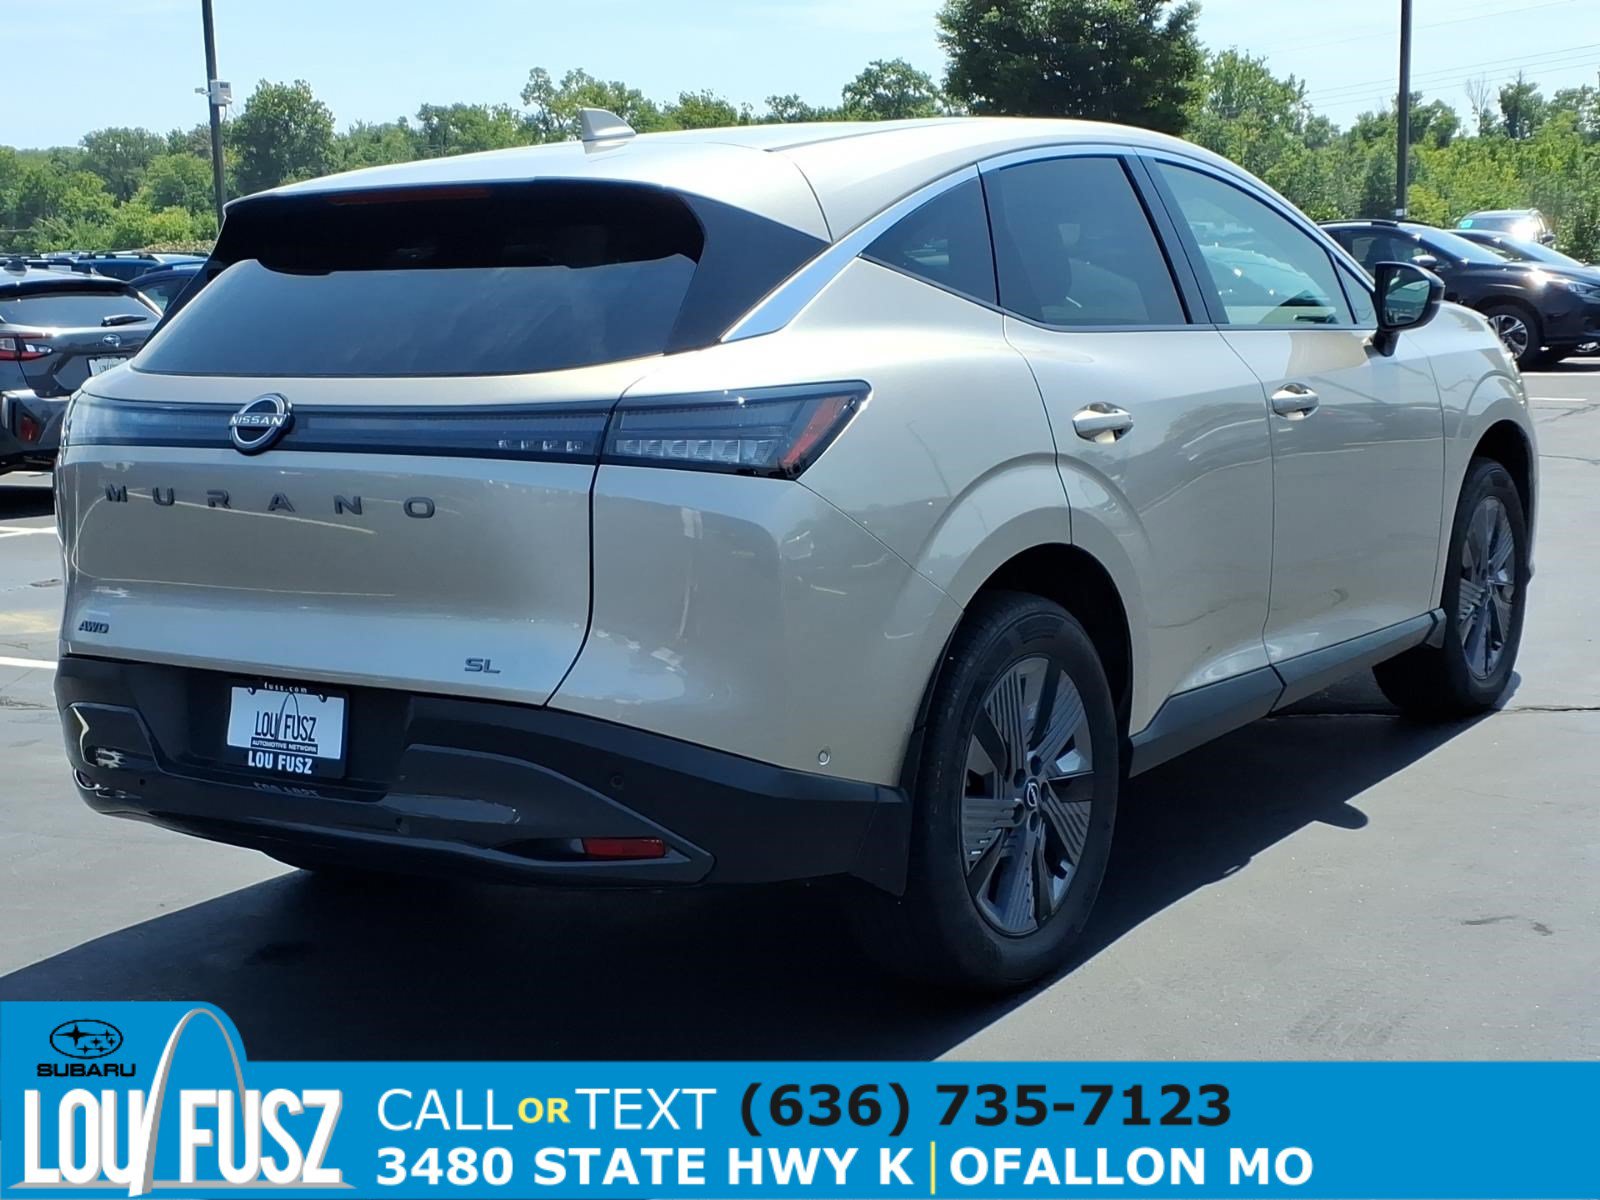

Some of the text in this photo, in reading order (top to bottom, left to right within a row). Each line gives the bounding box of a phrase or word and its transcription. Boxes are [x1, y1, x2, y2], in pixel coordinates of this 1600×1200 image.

[229, 415, 285, 426] NISSAN
[104, 483, 435, 519] MURANO
[78, 620, 110, 634] AWD
[464, 657, 502, 674] SL
[255, 711, 317, 743] LOU FUSZ
[252, 740, 317, 753] AUTOMOTIVE NETWORK
[248, 751, 313, 775] LOU FUSZ
